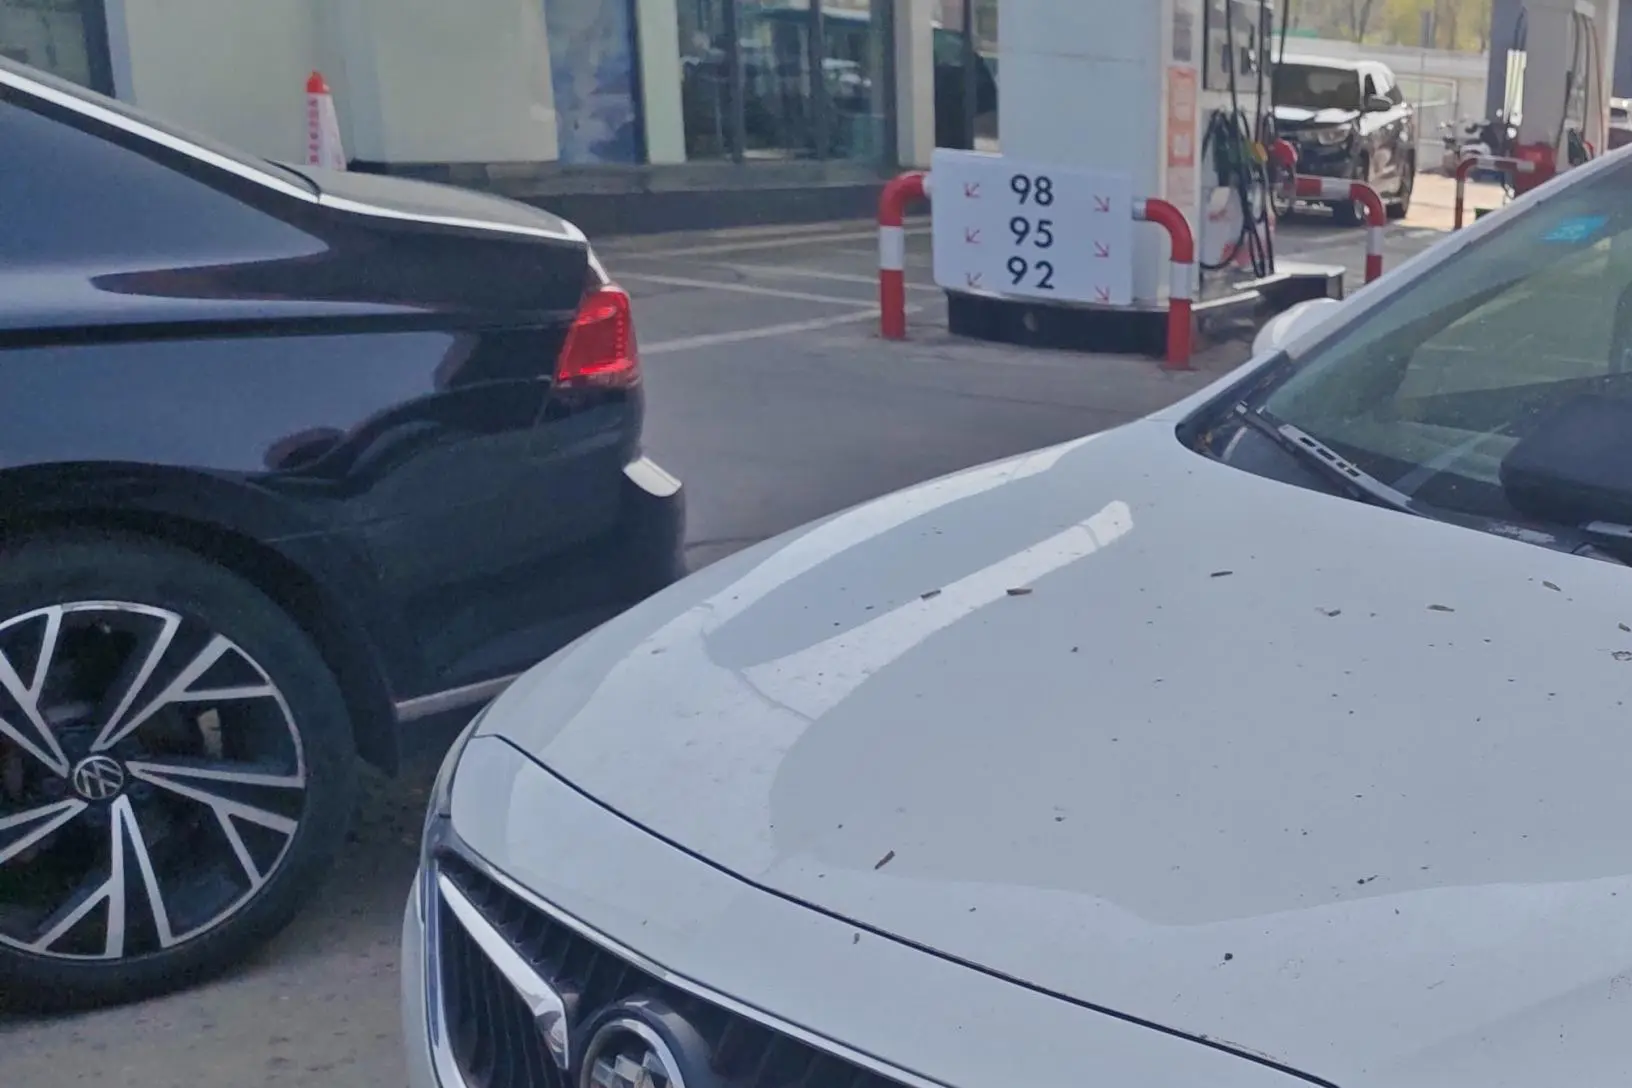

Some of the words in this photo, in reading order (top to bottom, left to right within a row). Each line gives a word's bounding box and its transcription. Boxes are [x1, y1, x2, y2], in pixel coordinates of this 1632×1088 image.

[1010, 174, 1054, 206] 98
[1009, 216, 1054, 248] 95
[1007, 256, 1054, 289] 92
